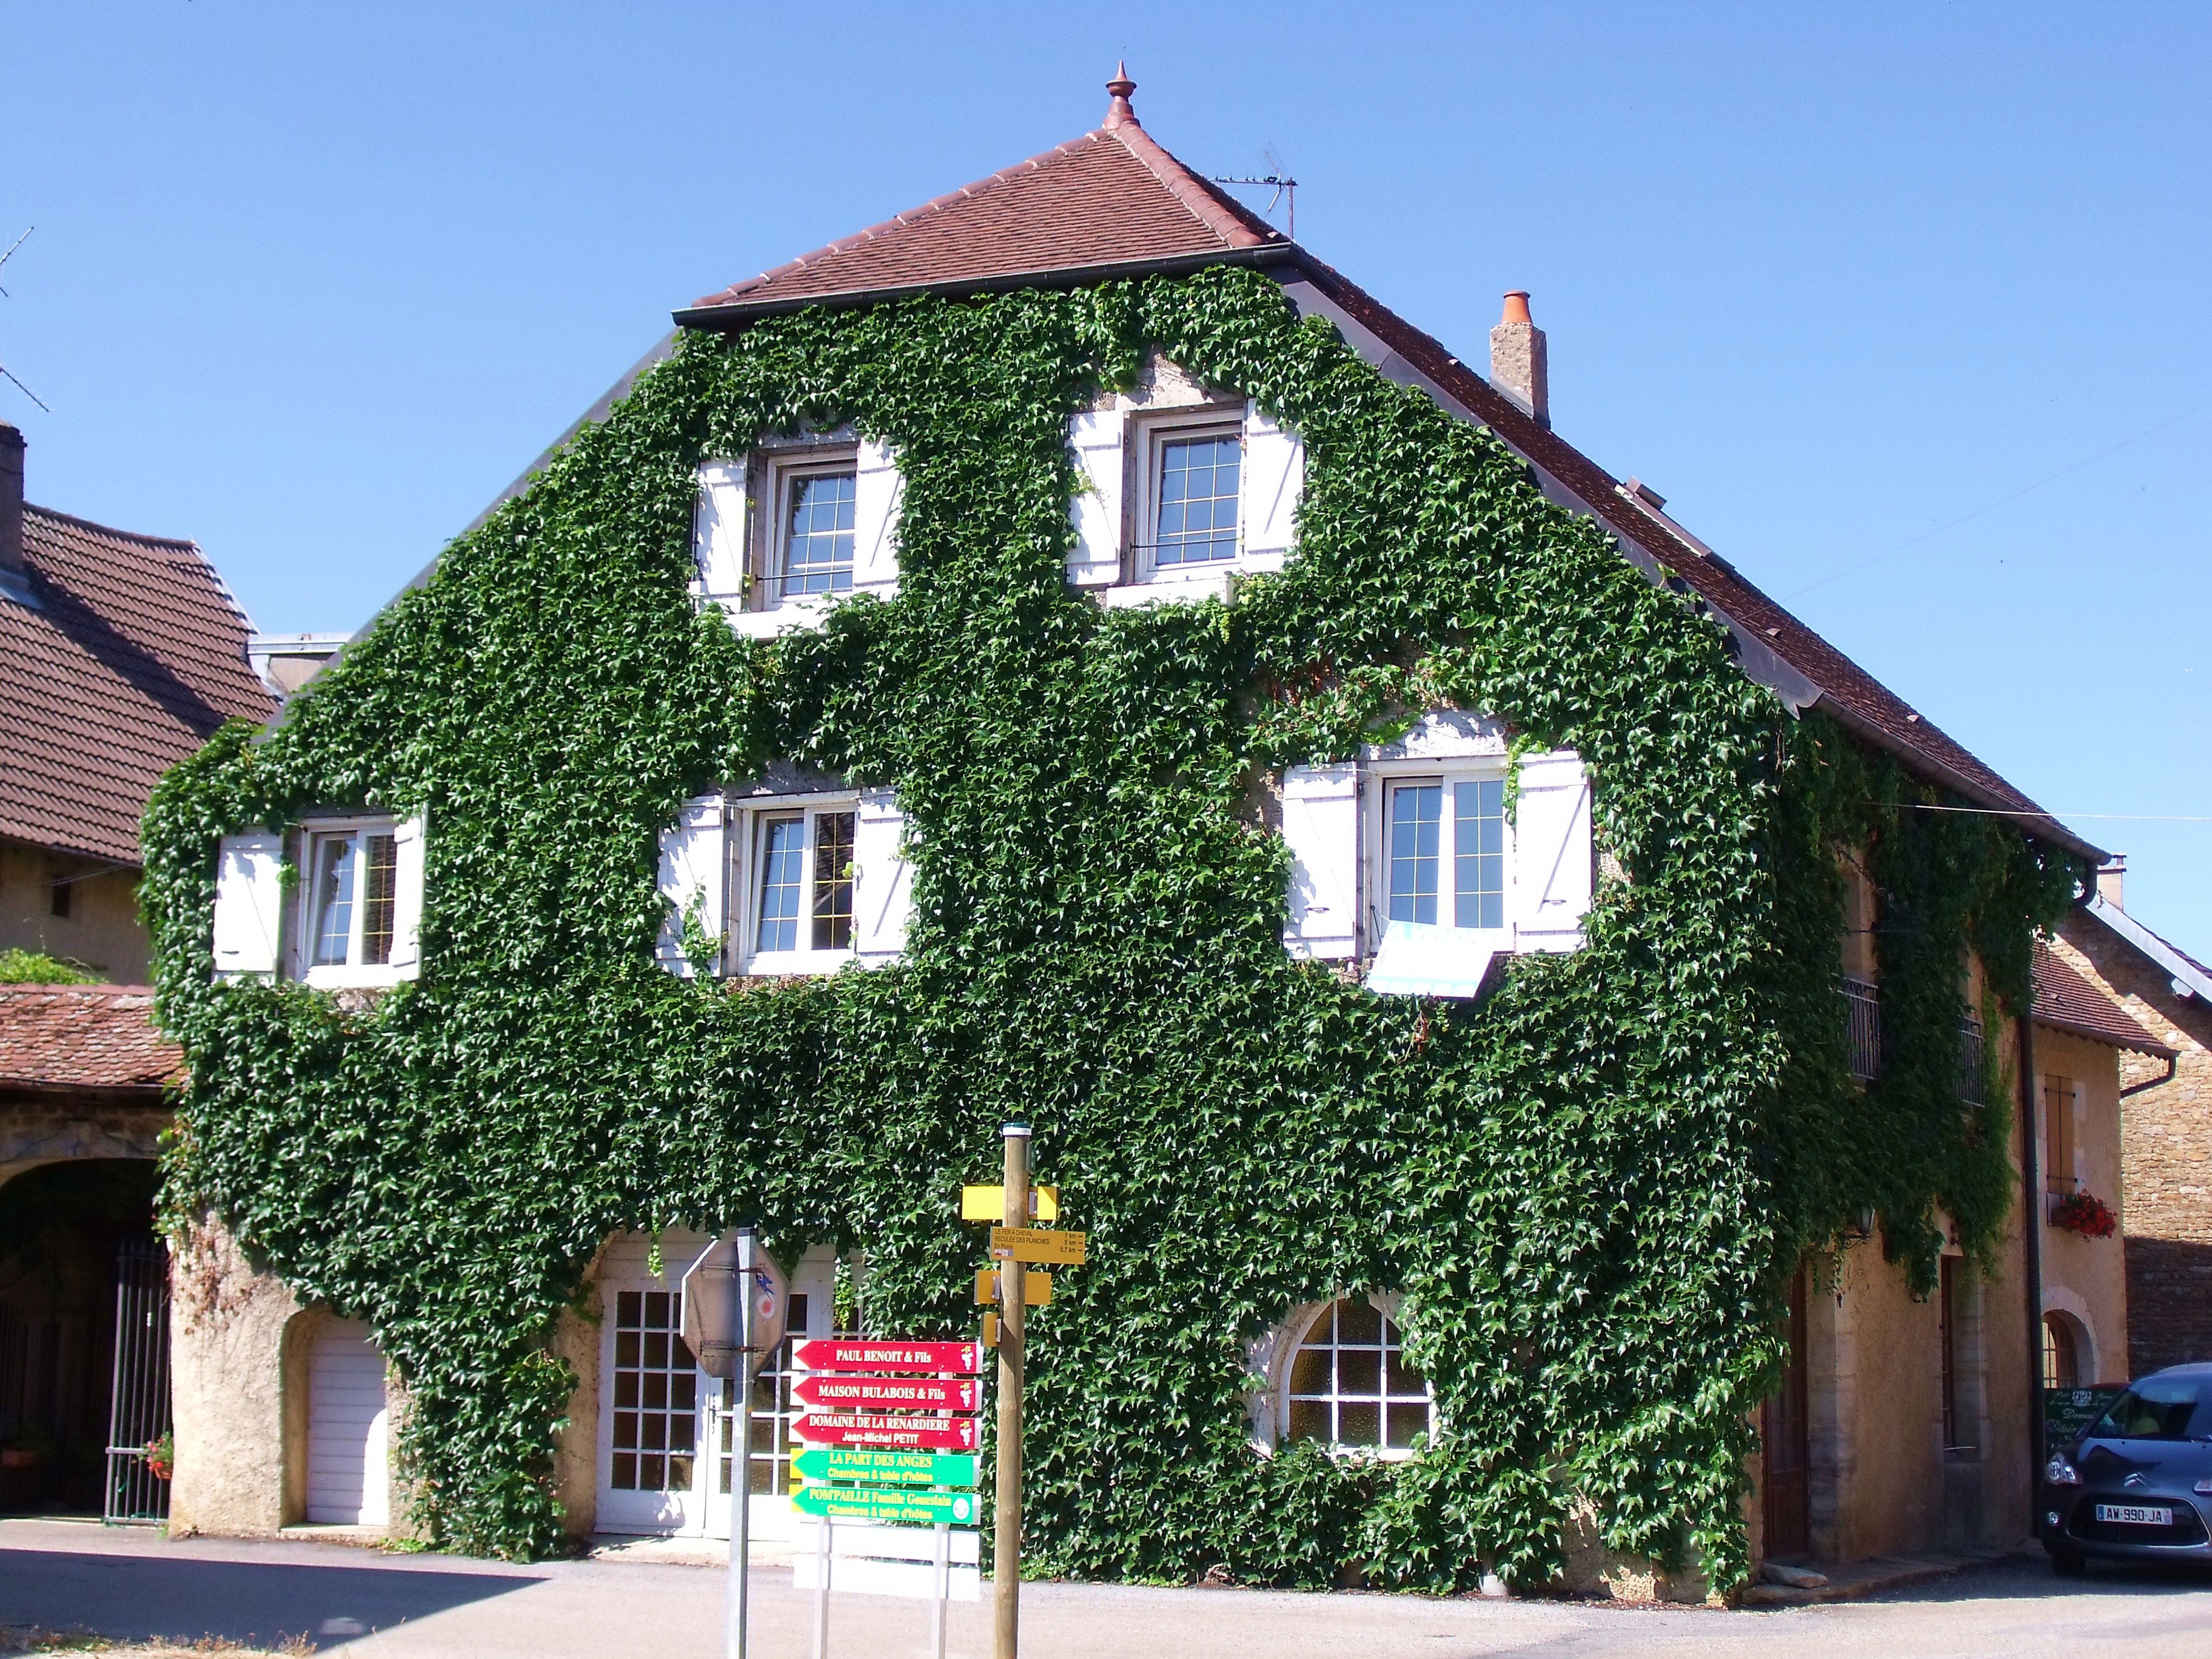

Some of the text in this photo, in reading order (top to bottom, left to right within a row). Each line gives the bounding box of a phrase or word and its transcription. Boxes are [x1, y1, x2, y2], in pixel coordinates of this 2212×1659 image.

[836, 1350, 932, 1363] PAUL BENOIT & Fils
[819, 1386, 945, 1400] MAISON BULABOIS & Fils
[809, 1415, 950, 1431] DOMAINE DE LA RENARDIERE
[842, 1431, 919, 1444] Jean-Michel PETIT
[830, 1453, 933, 1467] LA PART DES ANGES
[828, 1468, 869, 1479] Chambres
[872, 1470, 878, 1480] &
[880, 1470, 900, 1481] table
[871, 1491, 904, 1504] Famille
[827, 1505, 869, 1516] Chambres
[871, 1507, 877, 1517] &
[879, 1508, 899, 1518] table
